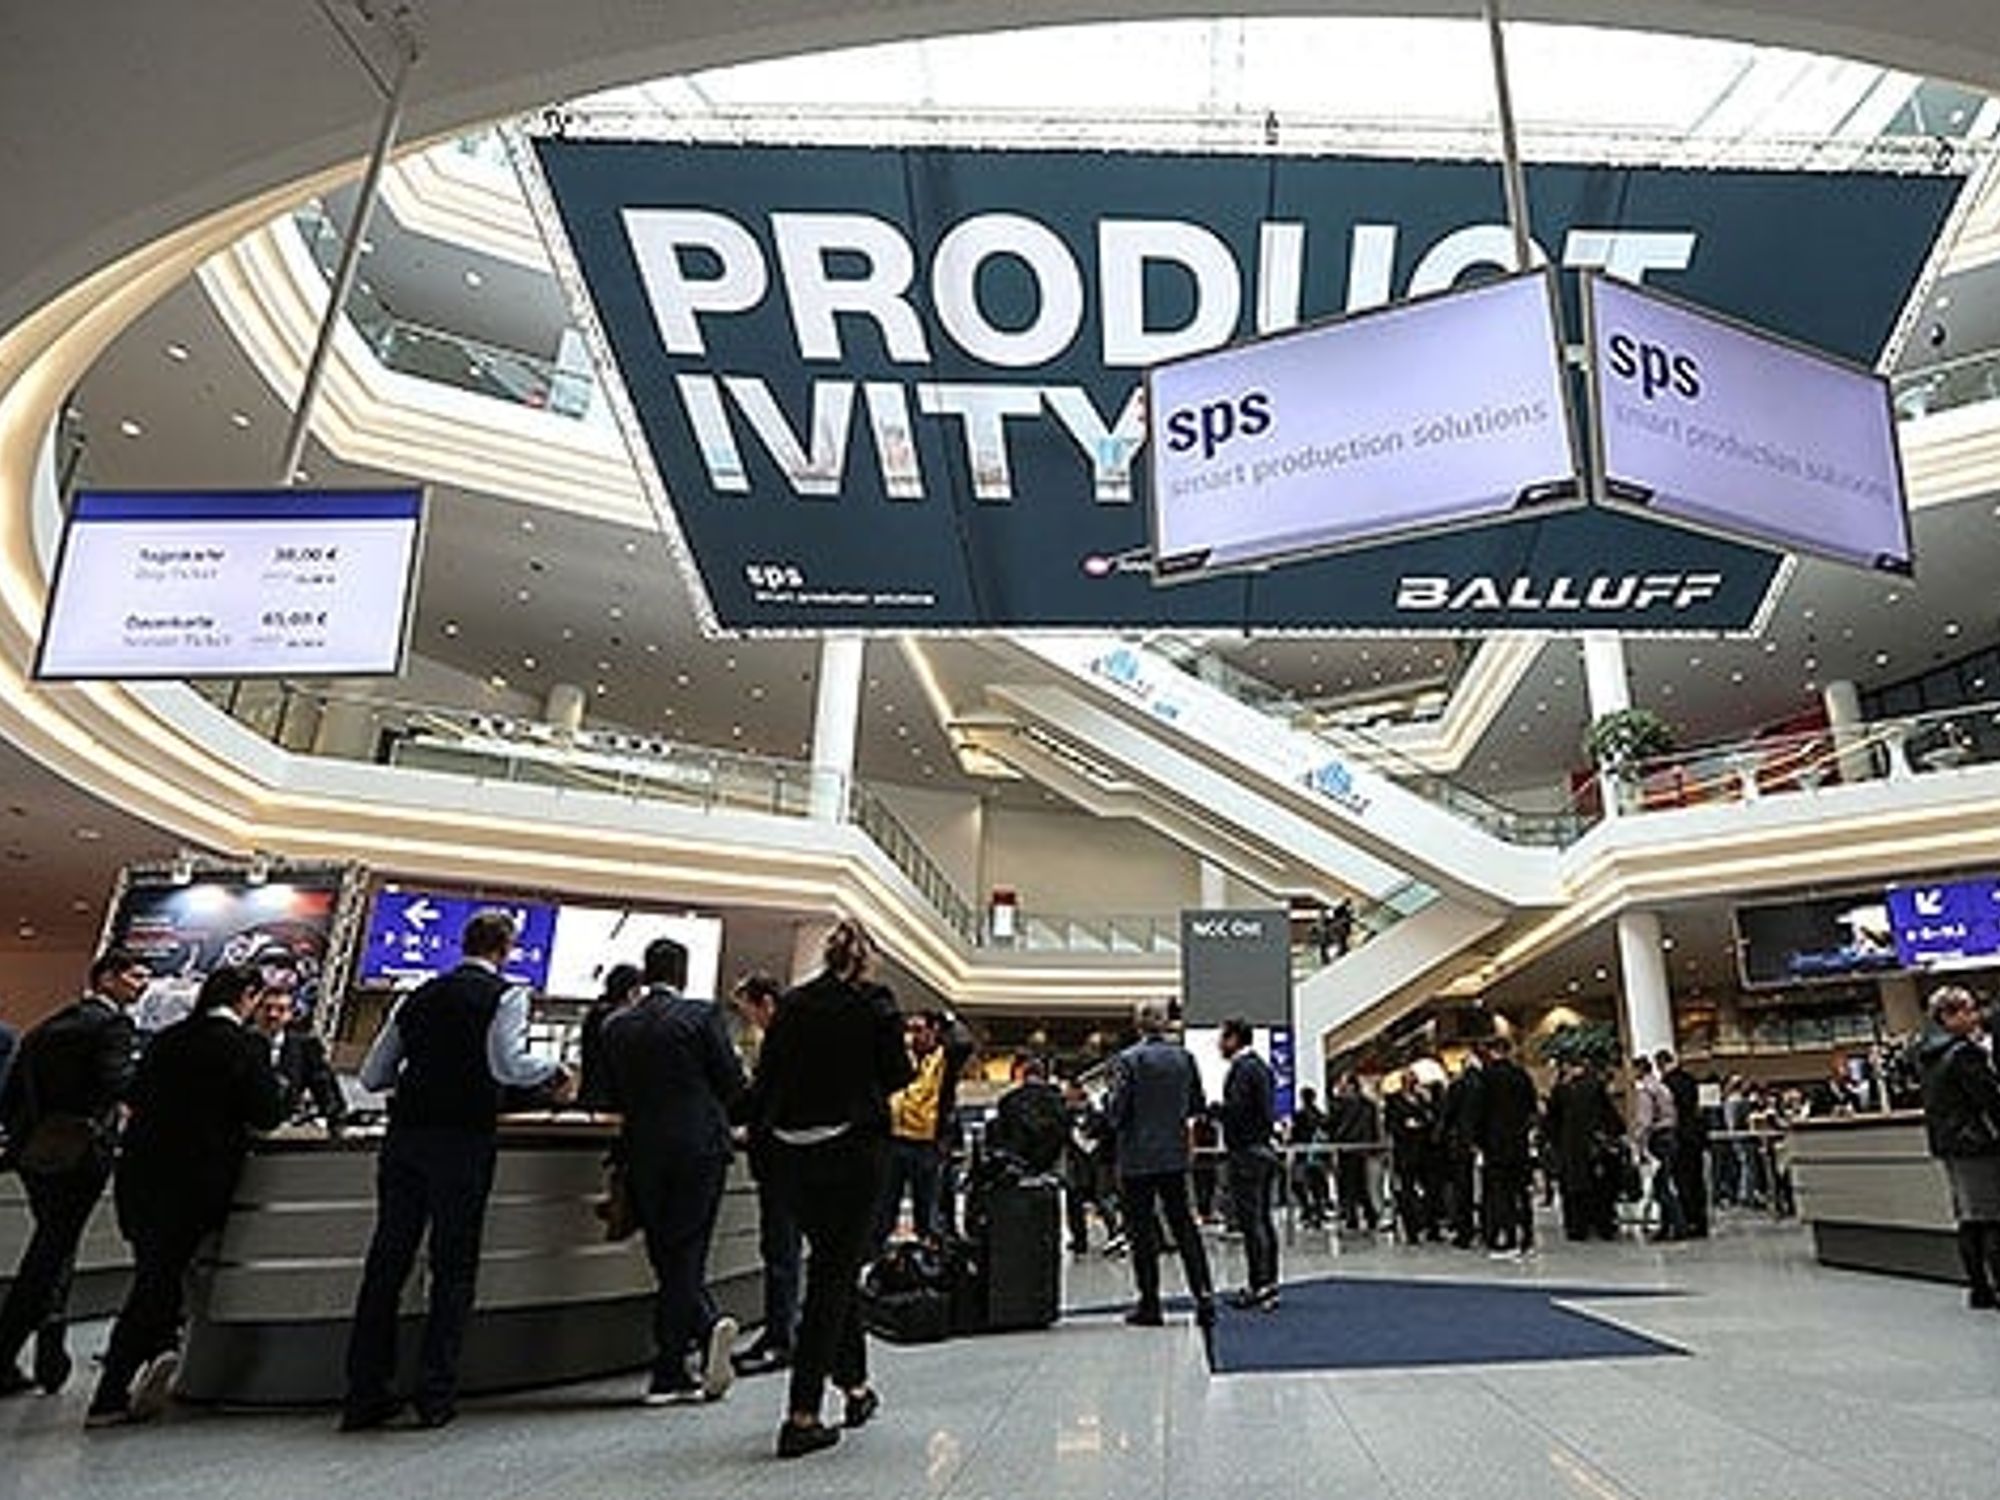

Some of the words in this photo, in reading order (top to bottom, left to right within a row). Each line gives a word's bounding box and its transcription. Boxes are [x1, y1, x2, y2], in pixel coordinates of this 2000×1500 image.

[1608, 334, 1700, 400] sps
[675, 373, 1149, 503] IVITY
[1166, 391, 1271, 459] sps
[1251, 432, 1403, 485] production
[1411, 399, 1548, 447] solutions
[1396, 573, 1722, 610] BALLUFF
